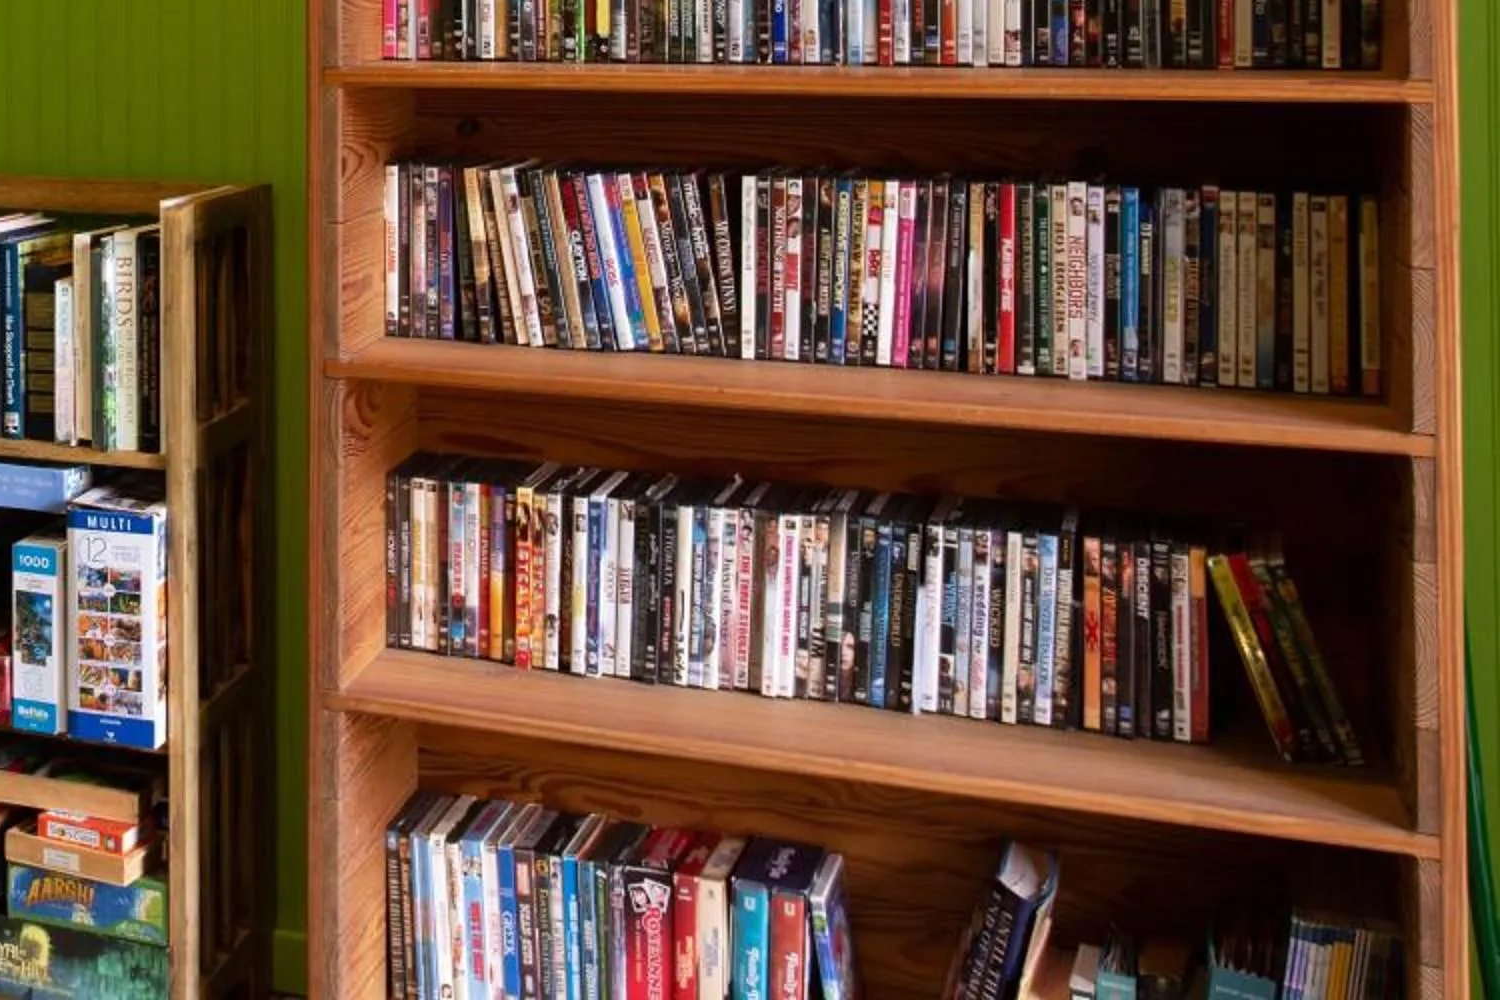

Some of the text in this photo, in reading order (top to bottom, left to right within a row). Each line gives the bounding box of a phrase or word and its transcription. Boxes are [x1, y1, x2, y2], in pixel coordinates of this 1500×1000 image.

[683, 182, 697, 216] music
[691, 227, 706, 258] lyrics
[571, 230, 587, 280] CLAYTON
[1068, 234, 1085, 318] NEIGHBORS
[116, 256, 133, 327] BIRDS
[3, 331, 14, 366] Stopped
[87, 514, 132, 531] MULTI
[18, 553, 49, 569] 1000
[84, 536, 108, 562] 12
[517, 549, 532, 627] STEALTH
[974, 584, 986, 637] wedding
[1137, 557, 1150, 619] DESCENT
[811, 626, 825, 658] TIM
[990, 588, 1001, 648] WICKED
[502, 911, 516, 954] GREEK
[643, 906, 666, 1000] ROSEANNE
[992, 910, 1014, 965] UNTIL
[744, 948, 760, 987] Family
[782, 952, 799, 994] Family
